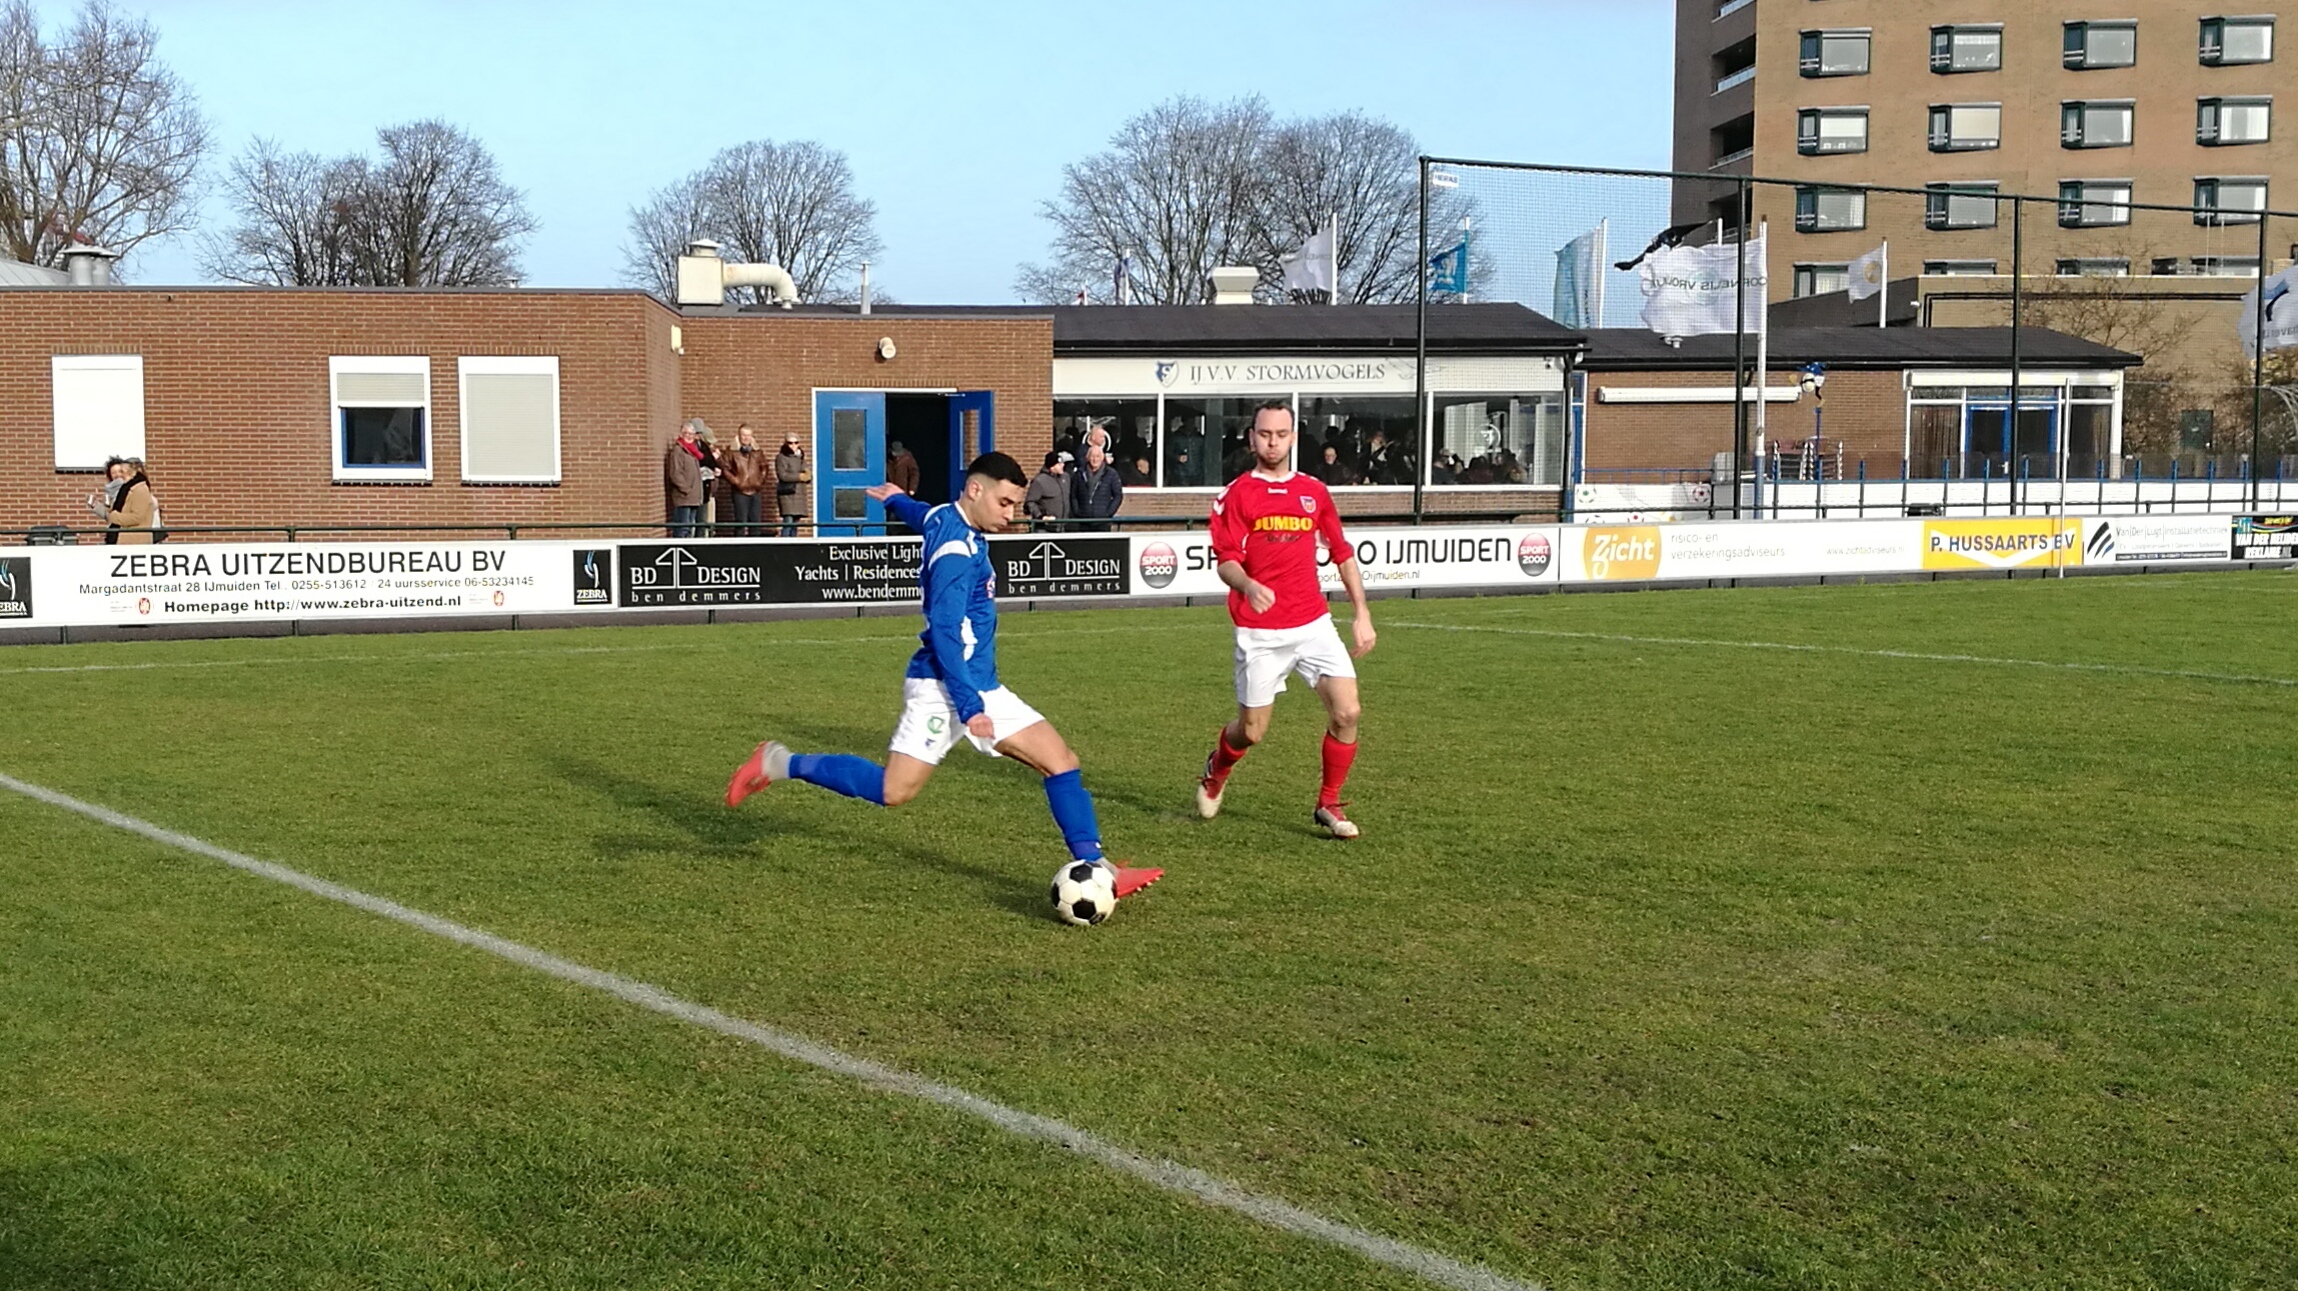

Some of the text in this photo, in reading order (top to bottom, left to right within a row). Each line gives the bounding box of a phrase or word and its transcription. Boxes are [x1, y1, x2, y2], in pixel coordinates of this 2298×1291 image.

[1247, 364, 1384, 380] STORMVOGELS
[1253, 515, 1313, 531] JUMBO
[1671, 532, 1719, 544] risico- en
[1931, 534, 2075, 552] P. HUSSAARTS BV
[829, 544, 921, 562] Exclusive Ligh
[1386, 538, 1511, 564] IJMUIDEN
[1520, 545, 1549, 555] SPORT
[1592, 534, 1655, 577] Zicht
[1671, 545, 1786, 562] verzekeringsadviseurs
[111, 551, 505, 577] ZEBRA UITZENDBUREAU BV
[1140, 555, 1176, 565] SPORT
[1522, 555, 1547, 564] 2000
[630, 567, 760, 584] BD DESIGN
[795, 565, 838, 580] Yachts
[1008, 560, 1119, 576] BD DESIGN
[1145, 566, 1172, 575] 2000
[80, 583, 181, 596] Margadantstraat
[186, 582, 200, 592] 28
[205, 582, 259, 591] IJmuiden
[292, 580, 366, 590] 0255-513612
[378, 579, 390, 588] 24
[395, 580, 460, 588] uursservice
[465, 577, 533, 586] 06-53234145
[576, 588, 608, 599] ZEBRA
[822, 583, 922, 600] www.bendemm
[1008, 582, 1120, 593] ben demmers
[632, 591, 760, 602] ben demmers
[165, 602, 248, 614] Homepage
[255, 596, 460, 613] http://www.zebra-uitzend.nl
